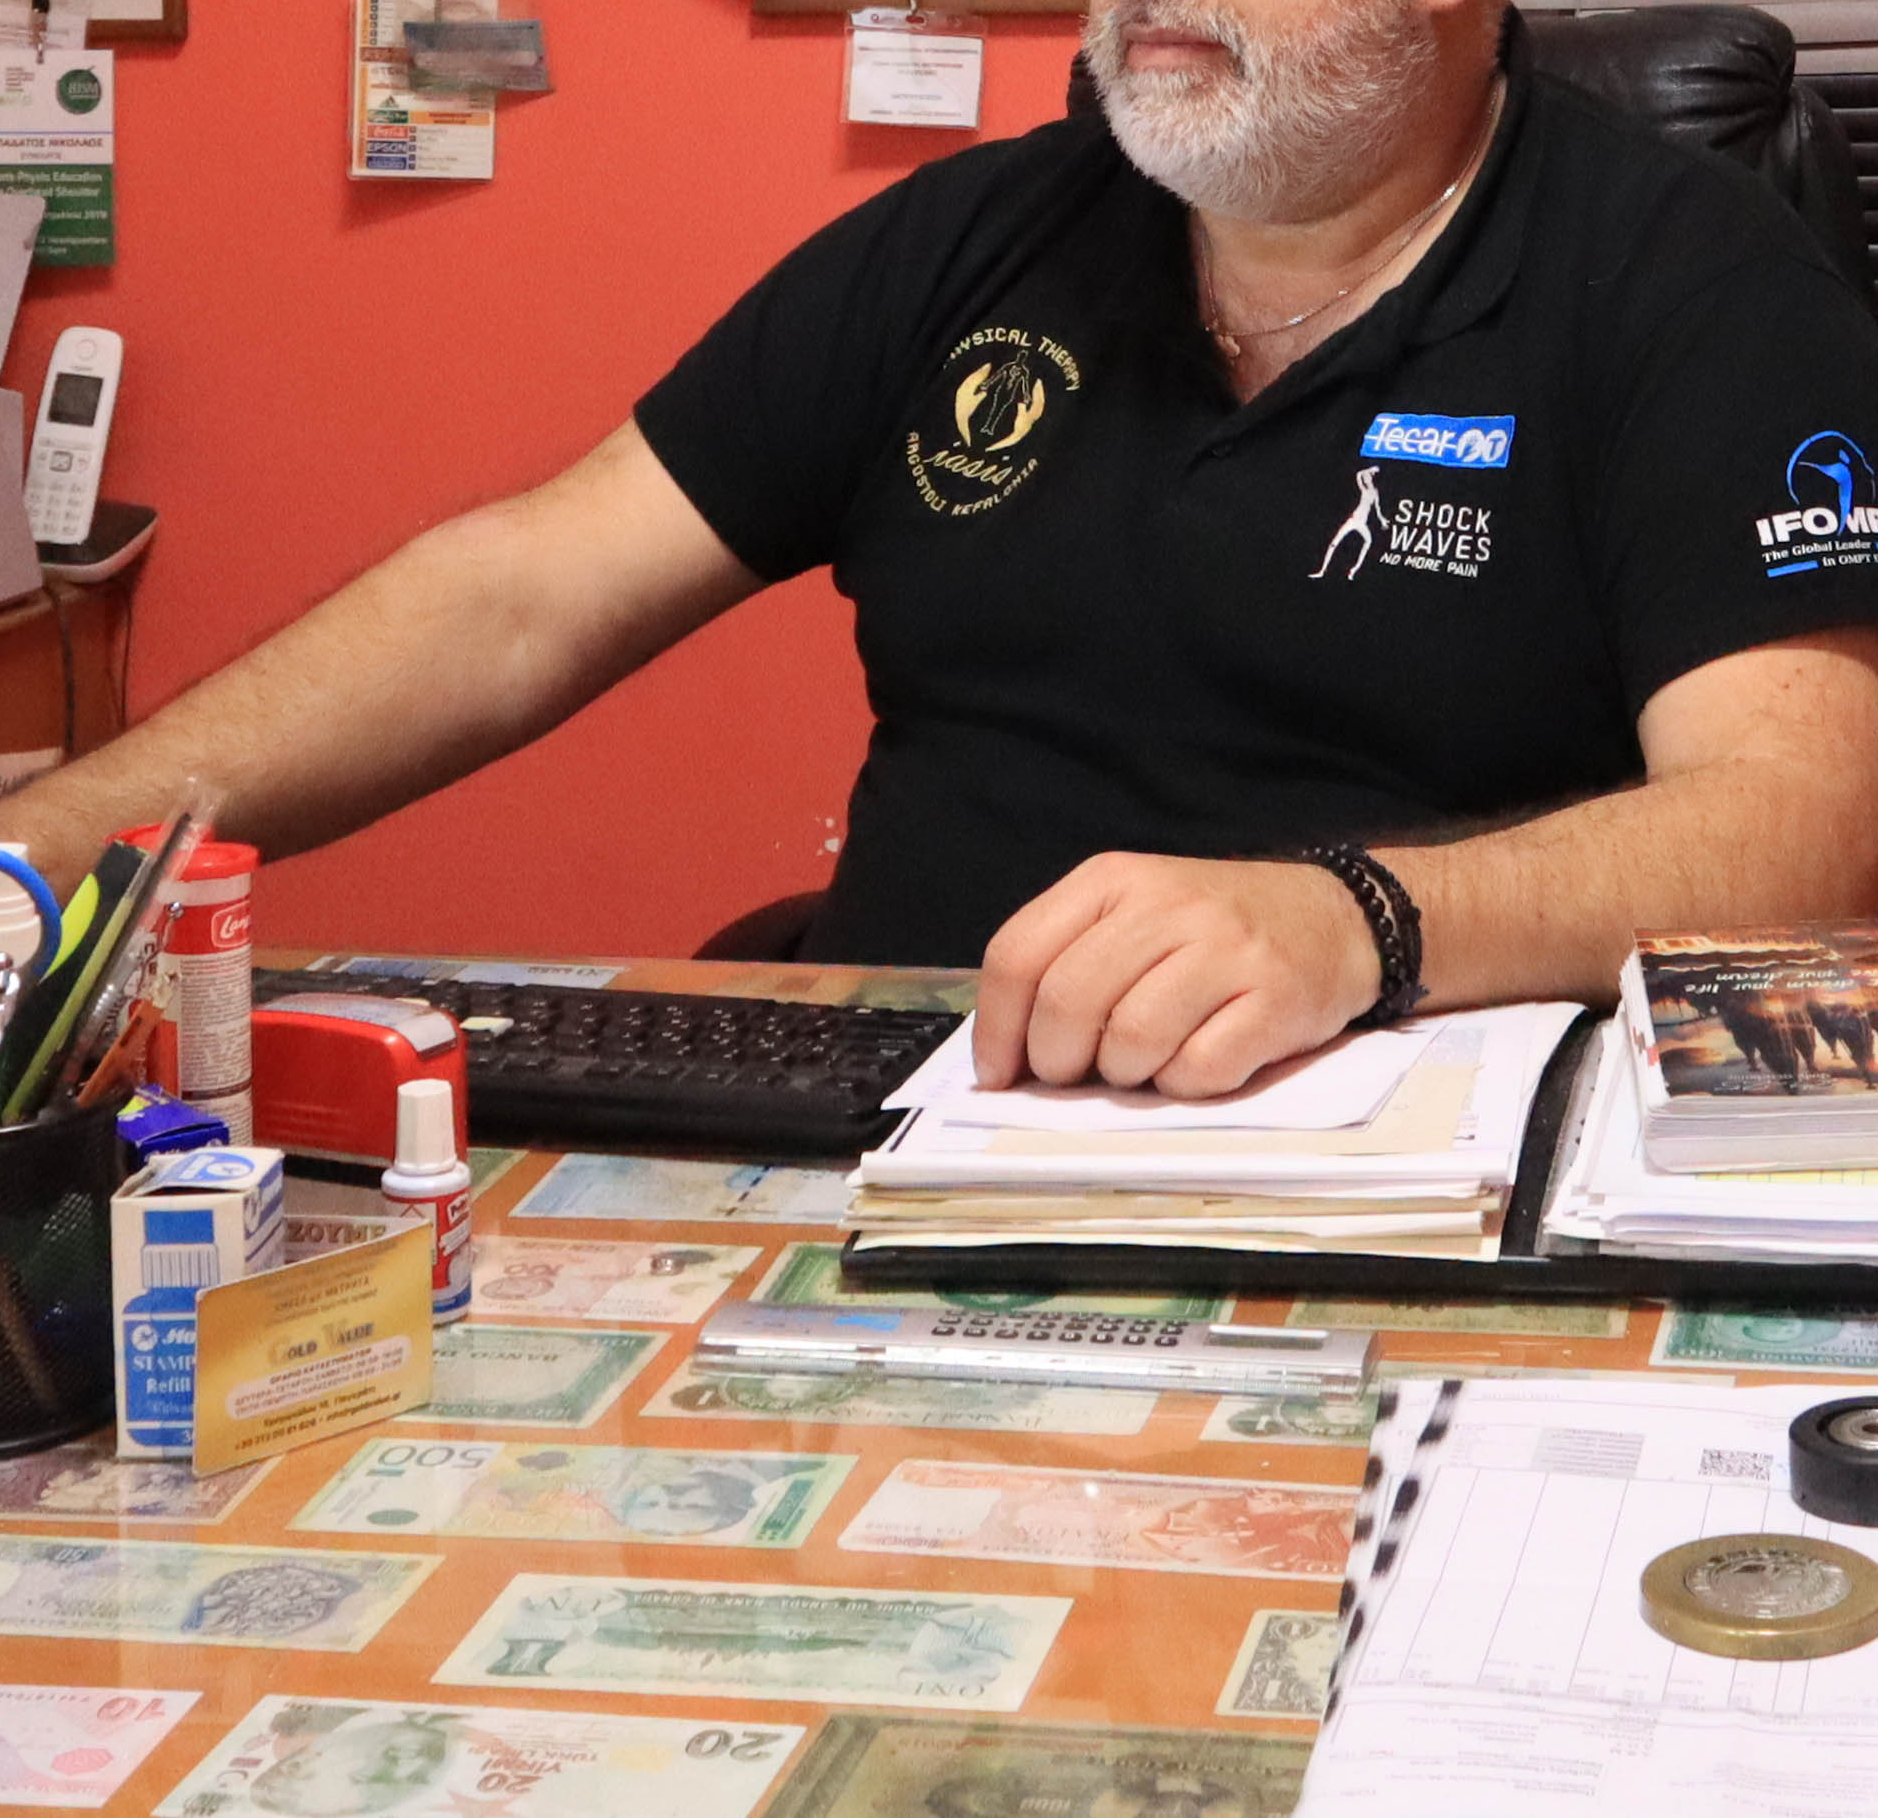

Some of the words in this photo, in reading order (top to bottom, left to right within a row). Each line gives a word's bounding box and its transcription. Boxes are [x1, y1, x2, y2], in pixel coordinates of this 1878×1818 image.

[942, 326, 1033, 370] YSICAL
[906, 430, 948, 513] ARGOSTOLI
[951, 457, 1040, 517] KEFALONIA
[1394, 498, 1492, 534] SHOCK
[1389, 523, 1493, 562] WAVES
[1762, 550, 1789, 564] The
[1791, 541, 1833, 556] Global
[1835, 538, 1872, 552] Leader
[1379, 552, 1403, 566] NO
[1404, 554, 1443, 573] MORE
[1446, 561, 1479, 579] PAIN
[1838, 553, 1871, 566] OMPT
[1683, 983, 1720, 995] life
[1715, 970, 1784, 983] dream
[1731, 981, 1774, 993] your
[286, 1221, 388, 1244] ΖΟΥΜΕ
[145, 1377, 191, 1394] Refill
[377, 1445, 494, 1469] 500
[96, 1696, 165, 1721] 10
[684, 1729, 783, 1763] 20
[475, 1772, 544, 1795] 20
